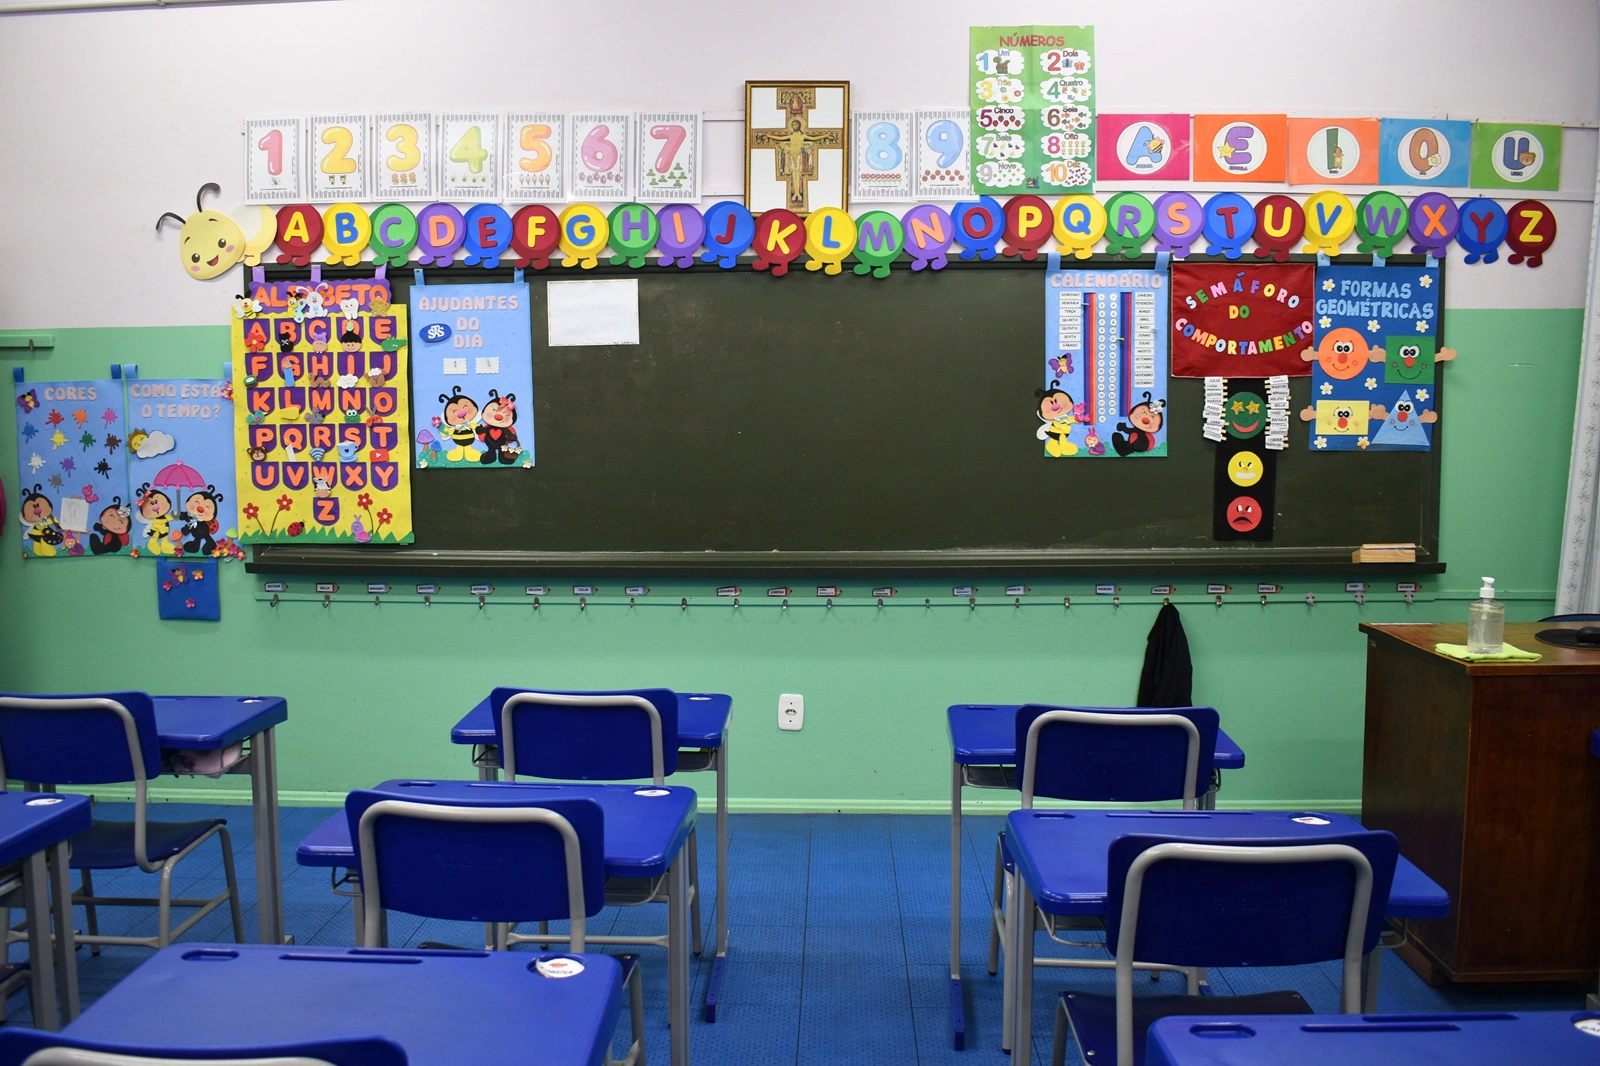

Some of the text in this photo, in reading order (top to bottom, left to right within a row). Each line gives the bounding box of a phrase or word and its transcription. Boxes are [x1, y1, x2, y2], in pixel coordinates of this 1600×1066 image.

[1000, 32, 1065, 47] NÚMEROS
[979, 52, 988, 70] 1
[1048, 52, 1061, 71] 2
[980, 81, 993, 99] 3
[1047, 82, 1061, 99] 4
[980, 110, 992, 128] 5
[1048, 109, 1060, 126] 6
[258, 130, 282, 176] 1
[321, 126, 356, 174] 2
[386, 124, 420, 172] 3
[450, 126, 488, 174] 4
[519, 124, 552, 173] 5
[581, 124, 618, 172] 6
[650, 125, 686, 174] 7
[865, 122, 902, 171] 8
[926, 120, 964, 168] 9
[982, 137, 994, 154] 7
[1048, 136, 1060, 154] 8
[1126, 126, 1162, 166] A
[1224, 126, 1254, 164] E
[1409, 128, 1438, 172] O
[1503, 136, 1529, 170] U
[980, 165, 992, 183] 9
[1046, 164, 1067, 182] 10
[284, 202, 1544, 254] A B C D E F G H I J K L M N O P Q R S T U V W X Y Z
[1050, 270, 1163, 288] CALENDÁRIO
[254, 284, 388, 308] ALFBETO
[1340, 280, 1412, 300] FORMAS
[419, 295, 518, 312] AJUDANTES
[1228, 305, 1250, 319] DO
[1316, 298, 1434, 319] GEOMÉTRICAS
[250, 322, 268, 342] A
[280, 322, 296, 342] B
[308, 320, 326, 340] C
[375, 319, 392, 340] E
[456, 317, 480, 330] DO
[454, 334, 484, 348] DIA
[1175, 318, 1313, 355] COMPORTAMENTO
[252, 356, 268, 376] F
[281, 355, 300, 376] G
[313, 355, 329, 376] H
[348, 354, 354, 374] I
[44, 387, 97, 401] CORES
[131, 382, 223, 398] COMO ESTÁ
[142, 404, 221, 419] O TEMPO?
[254, 390, 392, 412] K L M N O
[256, 426, 392, 450] P Q R S T
[255, 465, 394, 487] U V W X Y
[318, 500, 335, 521] Z
